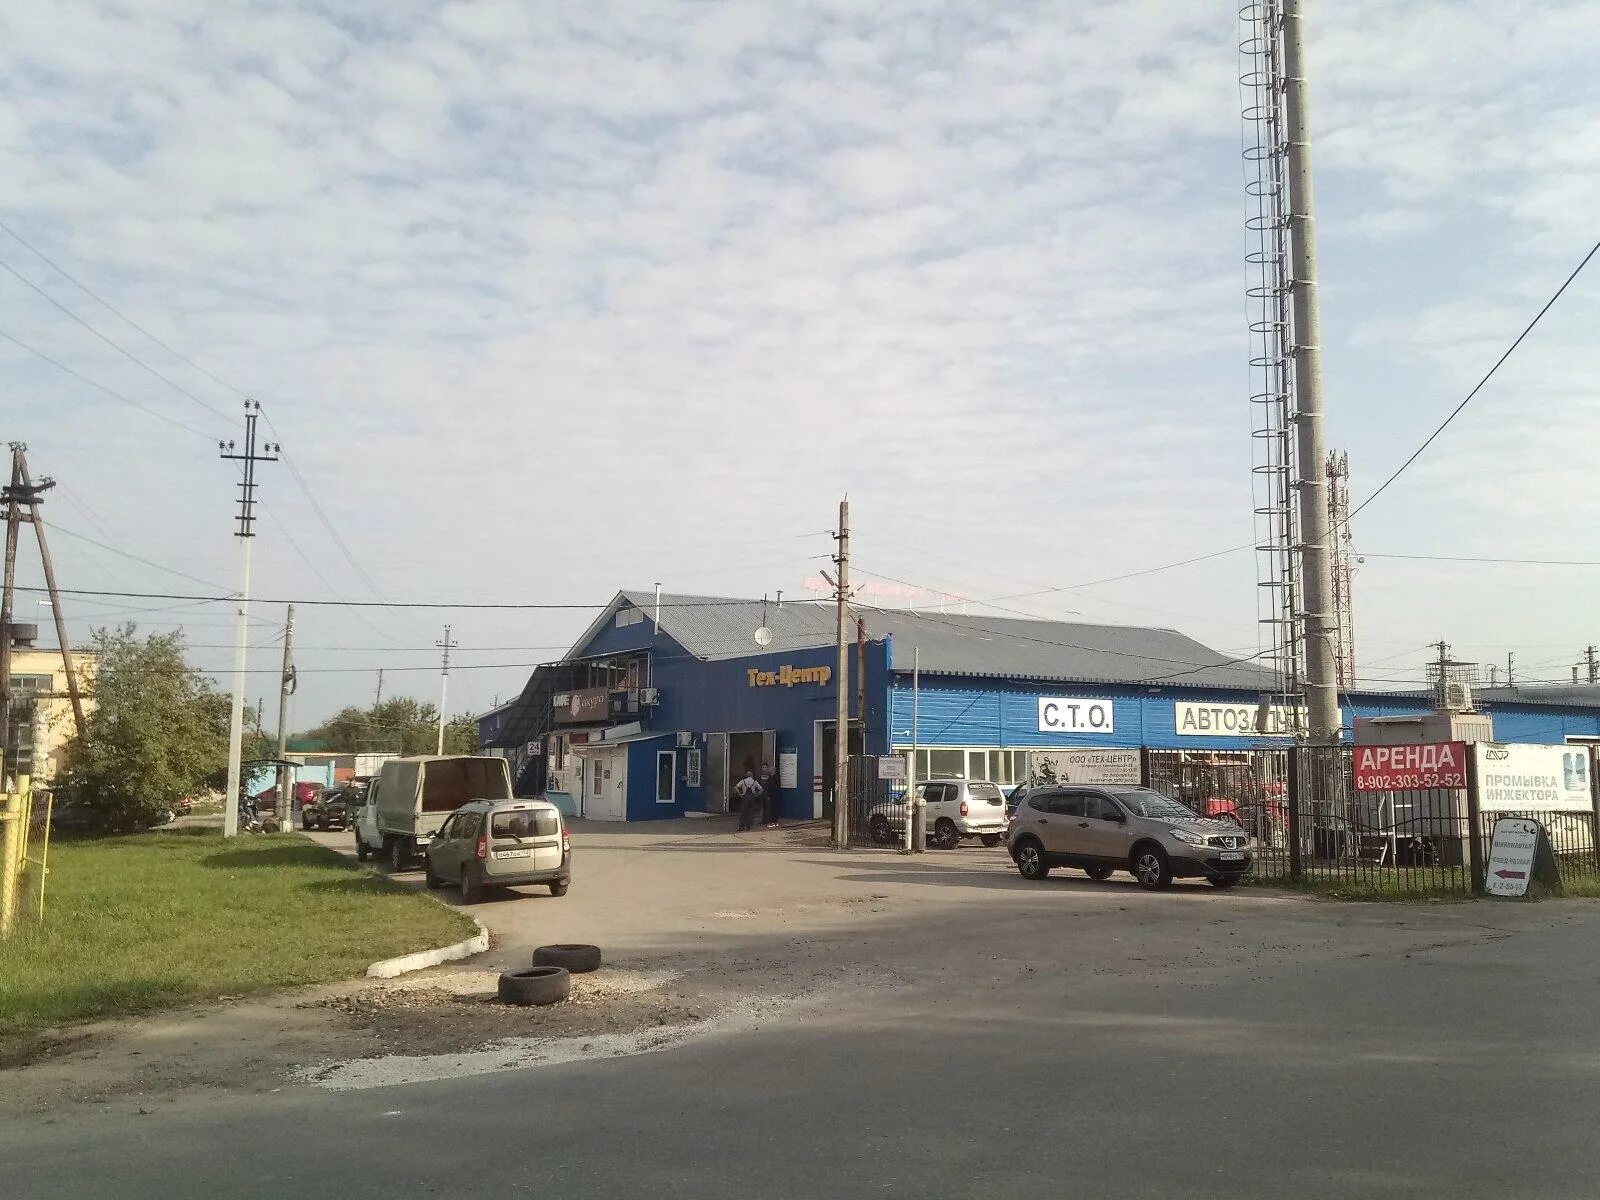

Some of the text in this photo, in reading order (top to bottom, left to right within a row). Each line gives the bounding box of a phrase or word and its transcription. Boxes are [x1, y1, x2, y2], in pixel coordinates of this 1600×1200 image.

[746, 664, 832, 688] Тех-Центр
[1043, 702, 1111, 729] С.Т.О.
[529, 742, 540, 751] 24
[1069, 754, 1137, 764] ООО «ТЕХ-ЦЕНТР»
[1360, 744, 1456, 772] АРЕНДА
[1357, 773, 1463, 789] 8-902-303-52-52
[1485, 774, 1558, 787] ПРОМЫВКА
[1486, 788, 1559, 801] ИНЖЕКТОРА
